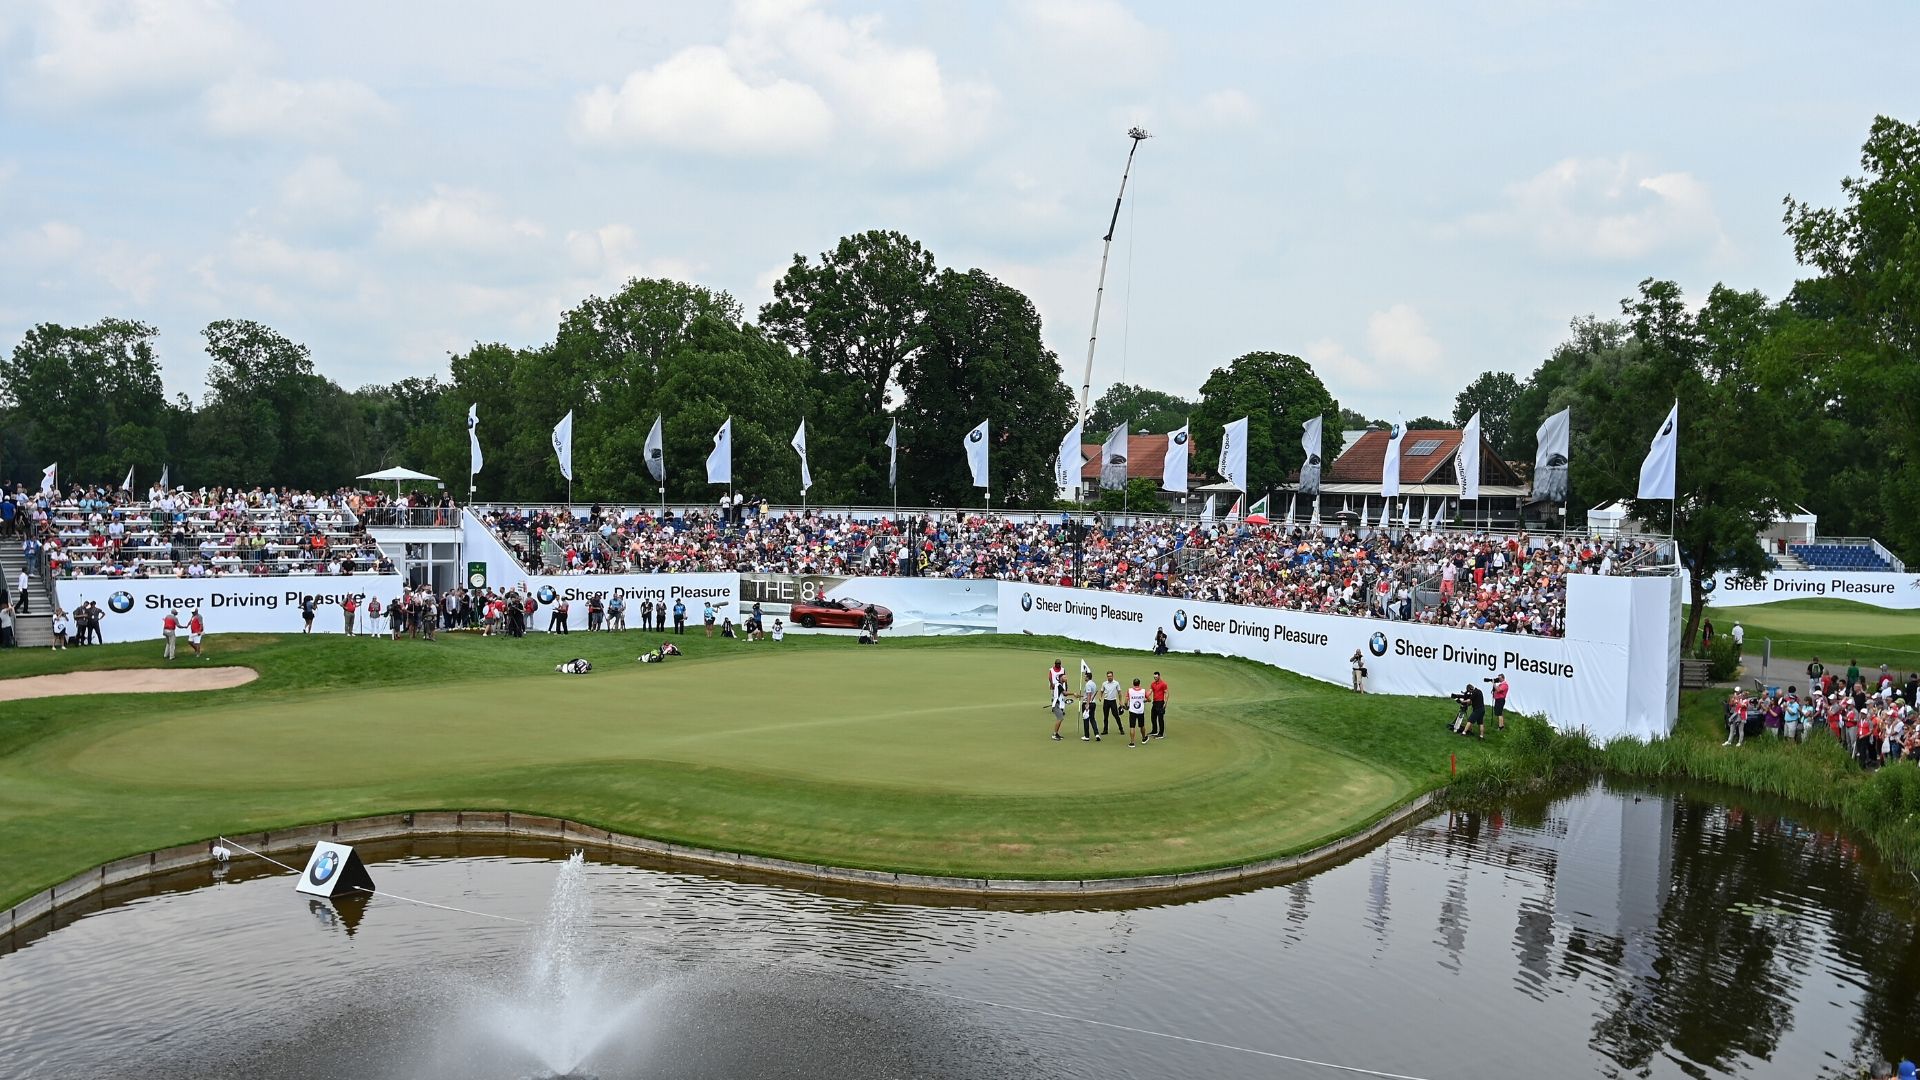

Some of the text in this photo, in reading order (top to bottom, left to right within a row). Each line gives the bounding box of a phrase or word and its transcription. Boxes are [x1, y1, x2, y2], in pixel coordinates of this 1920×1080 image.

[614, 586, 665, 600] Driving
[670, 585, 731, 599] Pleasure
[750, 579, 815, 601] THE 8
[1724, 576, 1895, 596] Sheer Driving Pleasure
[145, 591, 362, 612] Sheer Driving Plasue
[1036, 597, 1143, 623] Sheer Driving Pleasure
[1192, 614, 1328, 646] Sheer Driving Pleasure
[1395, 638, 1574, 678] Sheer Driving Pleasure
